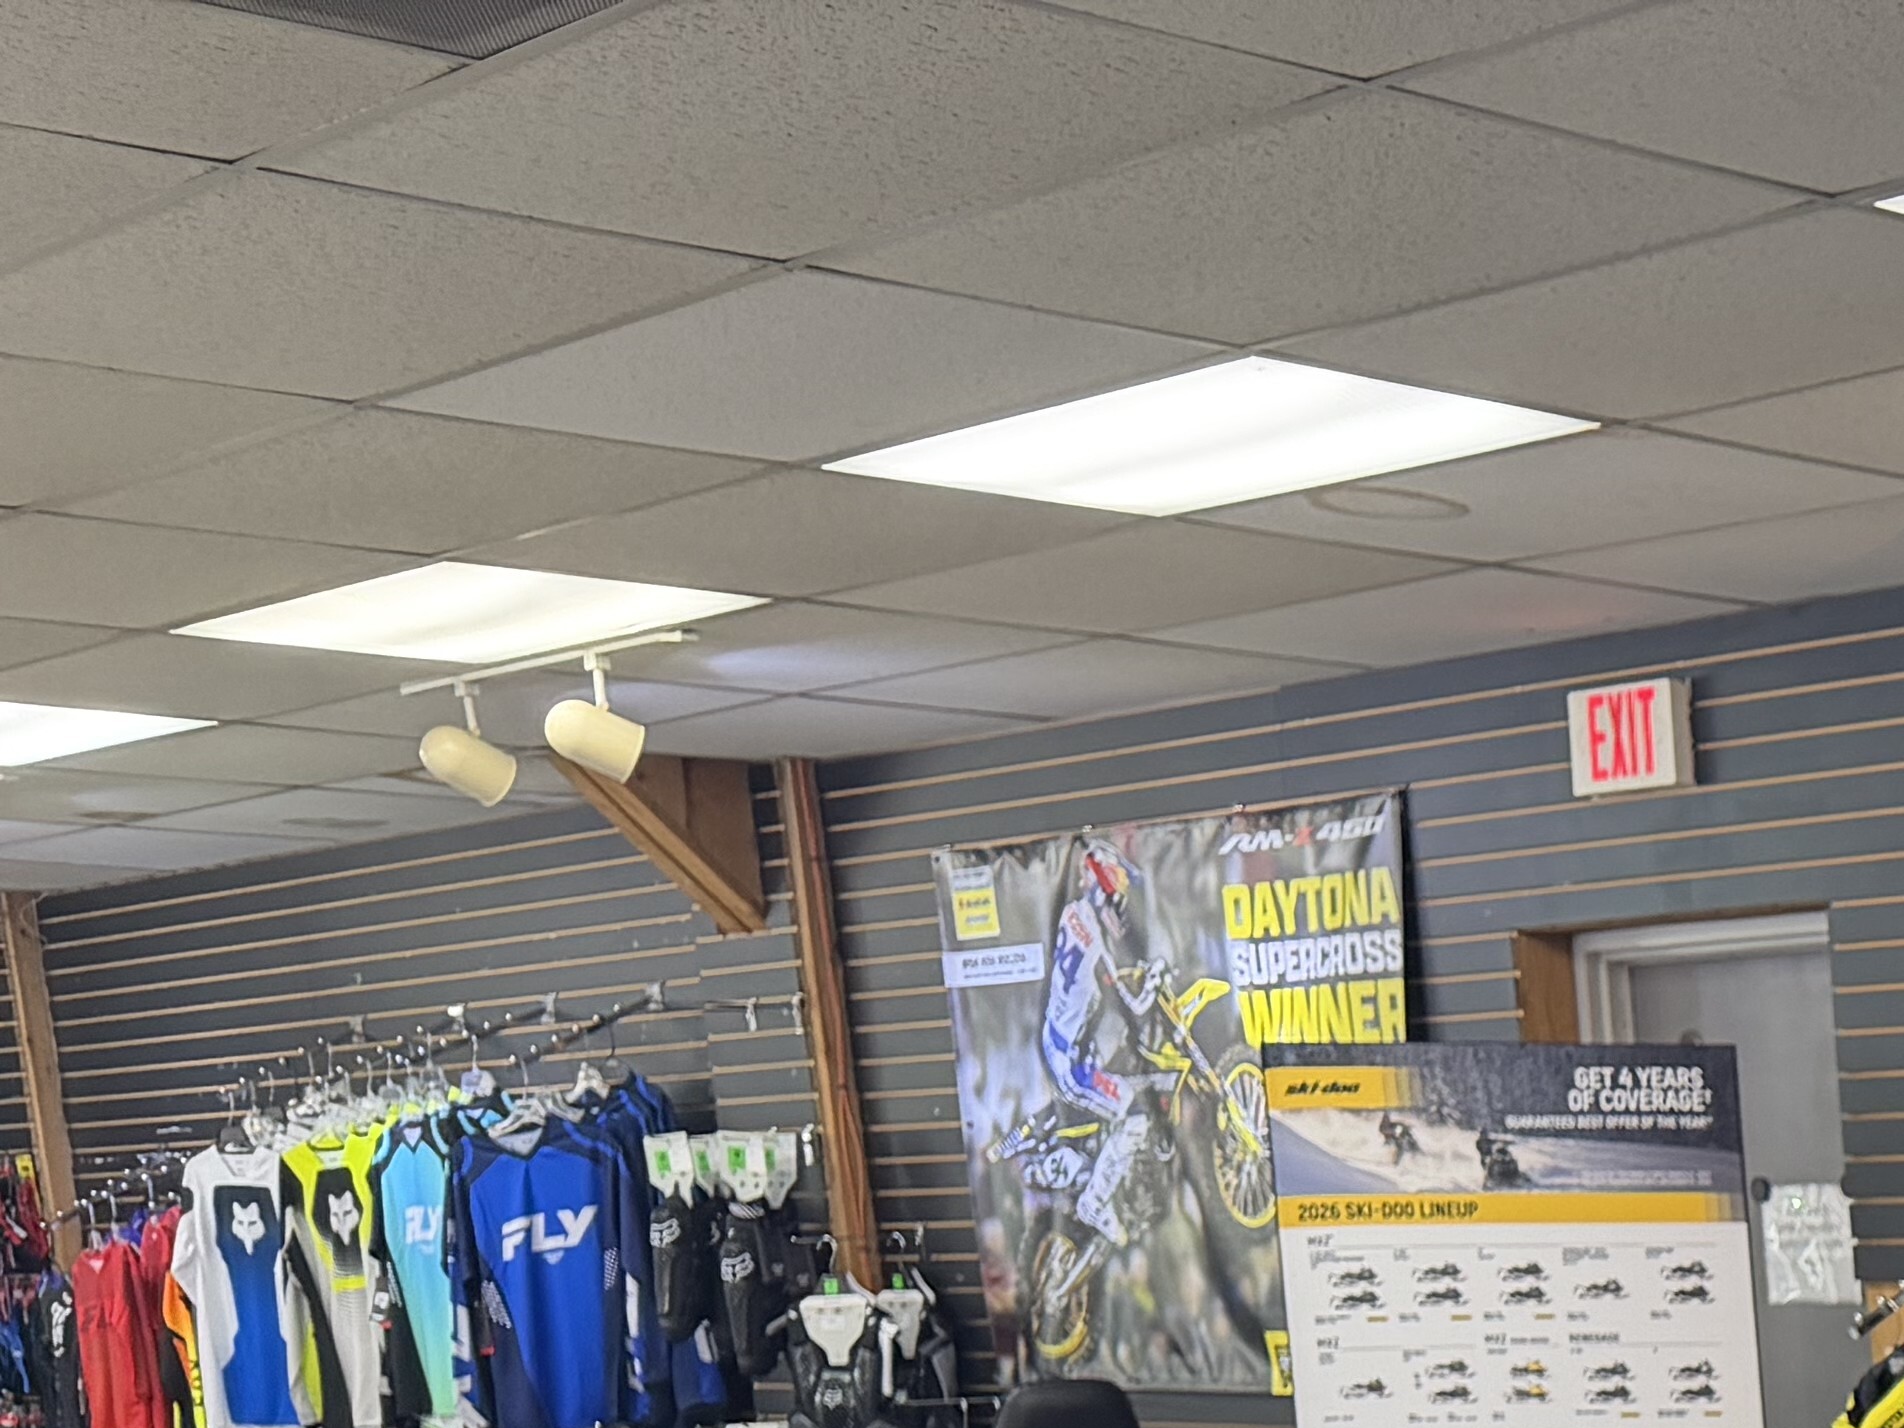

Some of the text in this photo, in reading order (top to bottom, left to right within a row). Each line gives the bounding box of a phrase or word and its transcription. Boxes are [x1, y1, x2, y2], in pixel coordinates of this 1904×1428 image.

[1588, 687, 1654, 781] EXIT
[1315, 814, 1387, 842] 450
[1222, 866, 1399, 940] DAYTONA
[1231, 929, 1402, 987] SUPERCROSS
[1237, 977, 1406, 1050] WINNER
[1567, 1089, 1595, 1112] OF
[1574, 1066, 1704, 1090] GET 4 YEARS
[405, 1204, 442, 1245] FLY
[502, 1204, 598, 1262] FLY
[1298, 1201, 1479, 1222] 2026 SKI-DOO LINEUP
